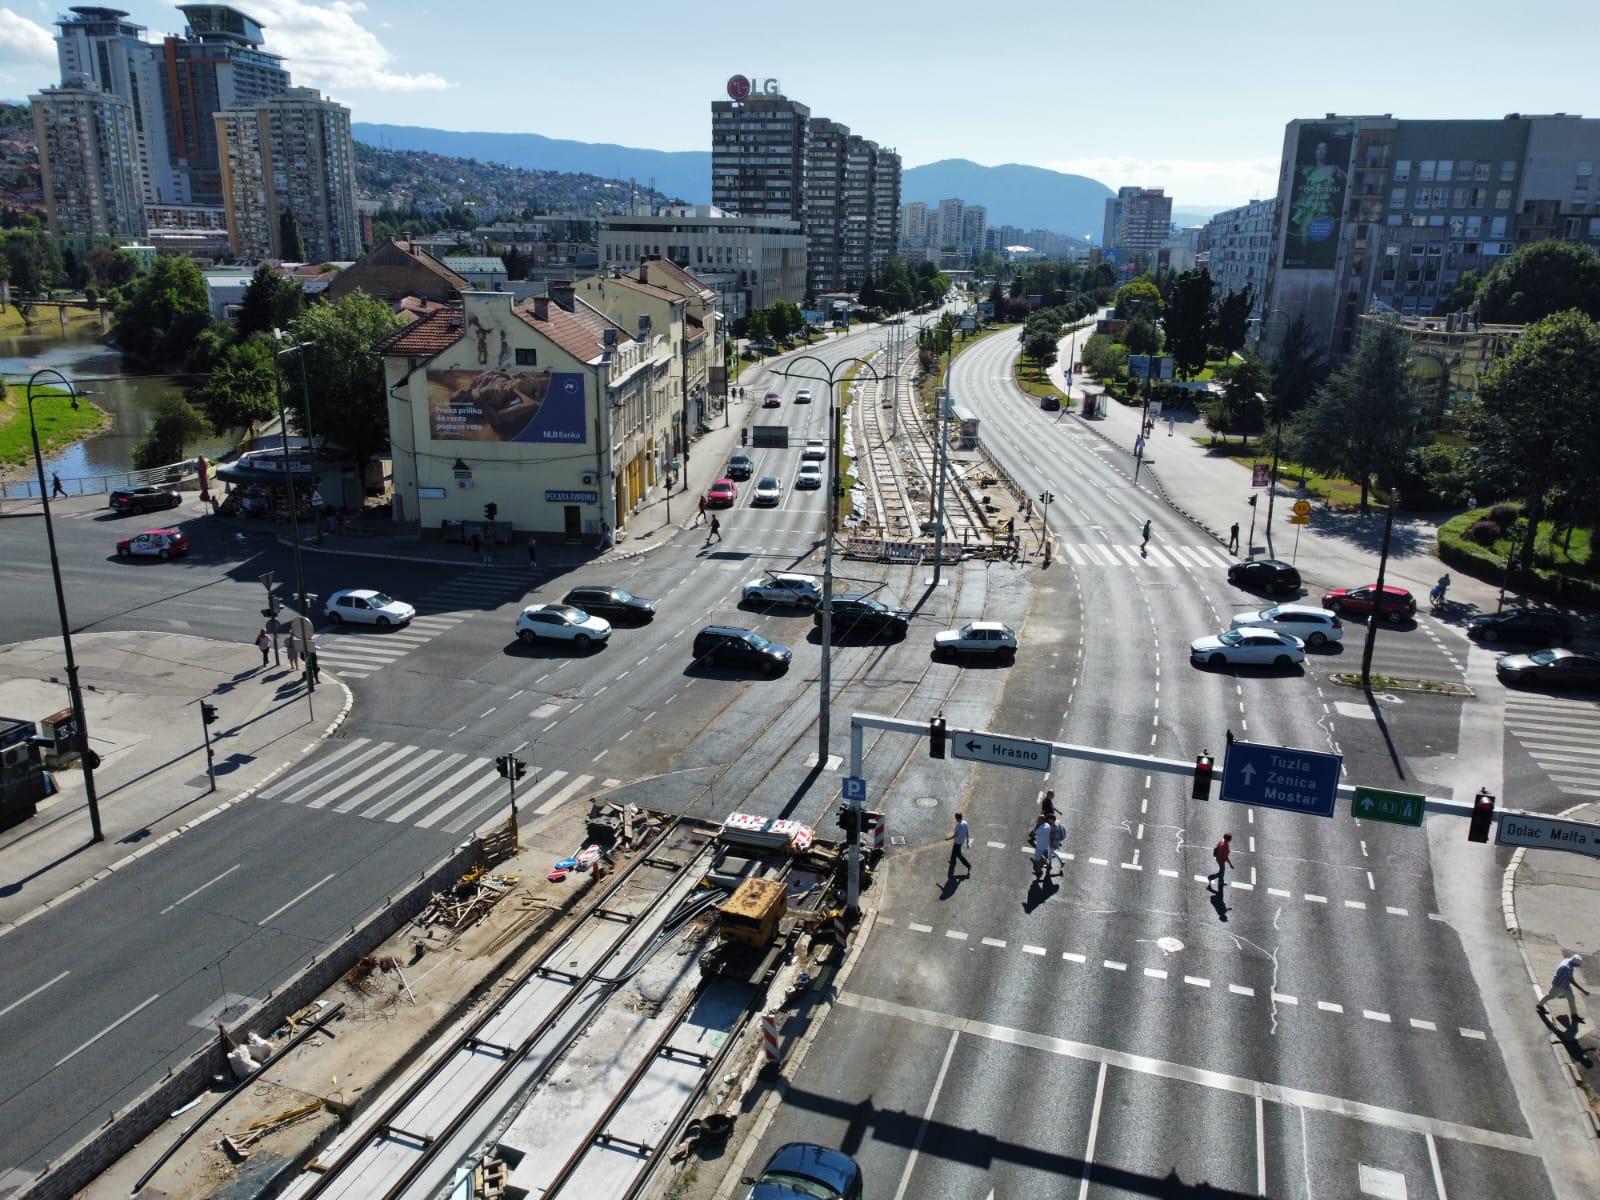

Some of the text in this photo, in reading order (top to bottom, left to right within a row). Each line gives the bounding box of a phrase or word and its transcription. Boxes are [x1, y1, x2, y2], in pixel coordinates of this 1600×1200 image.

[992, 743, 1039, 760] Hrasno
[1269, 754, 1311, 772] Tuzla
[847, 780, 861, 797] P
[1266, 771, 1317, 790] Zenica
[1264, 786, 1319, 806] Mostar
[1507, 823, 1587, 844] Dolac Malta
